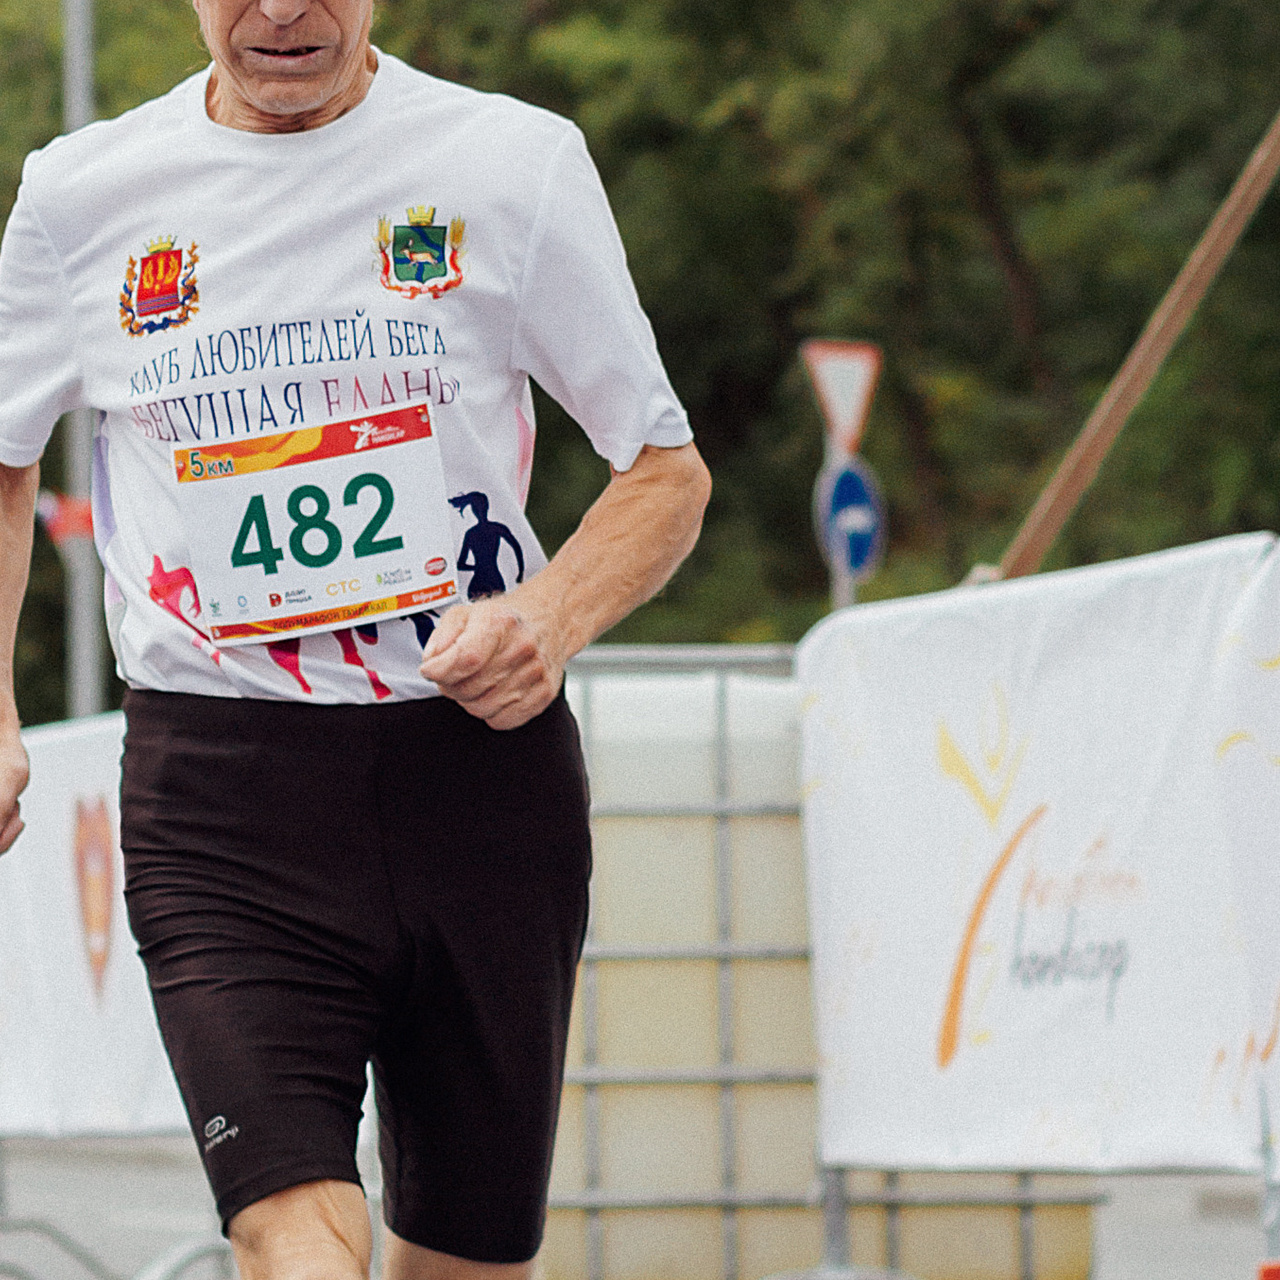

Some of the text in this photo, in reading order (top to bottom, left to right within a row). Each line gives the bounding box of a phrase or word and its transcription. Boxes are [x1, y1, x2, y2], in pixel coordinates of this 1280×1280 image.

[129, 309, 446, 397] КЛУБ ЛЮБИТЕЛЕЙ БЕГА
[190, 451, 202, 477] 5
[230, 472, 404, 576] 482
